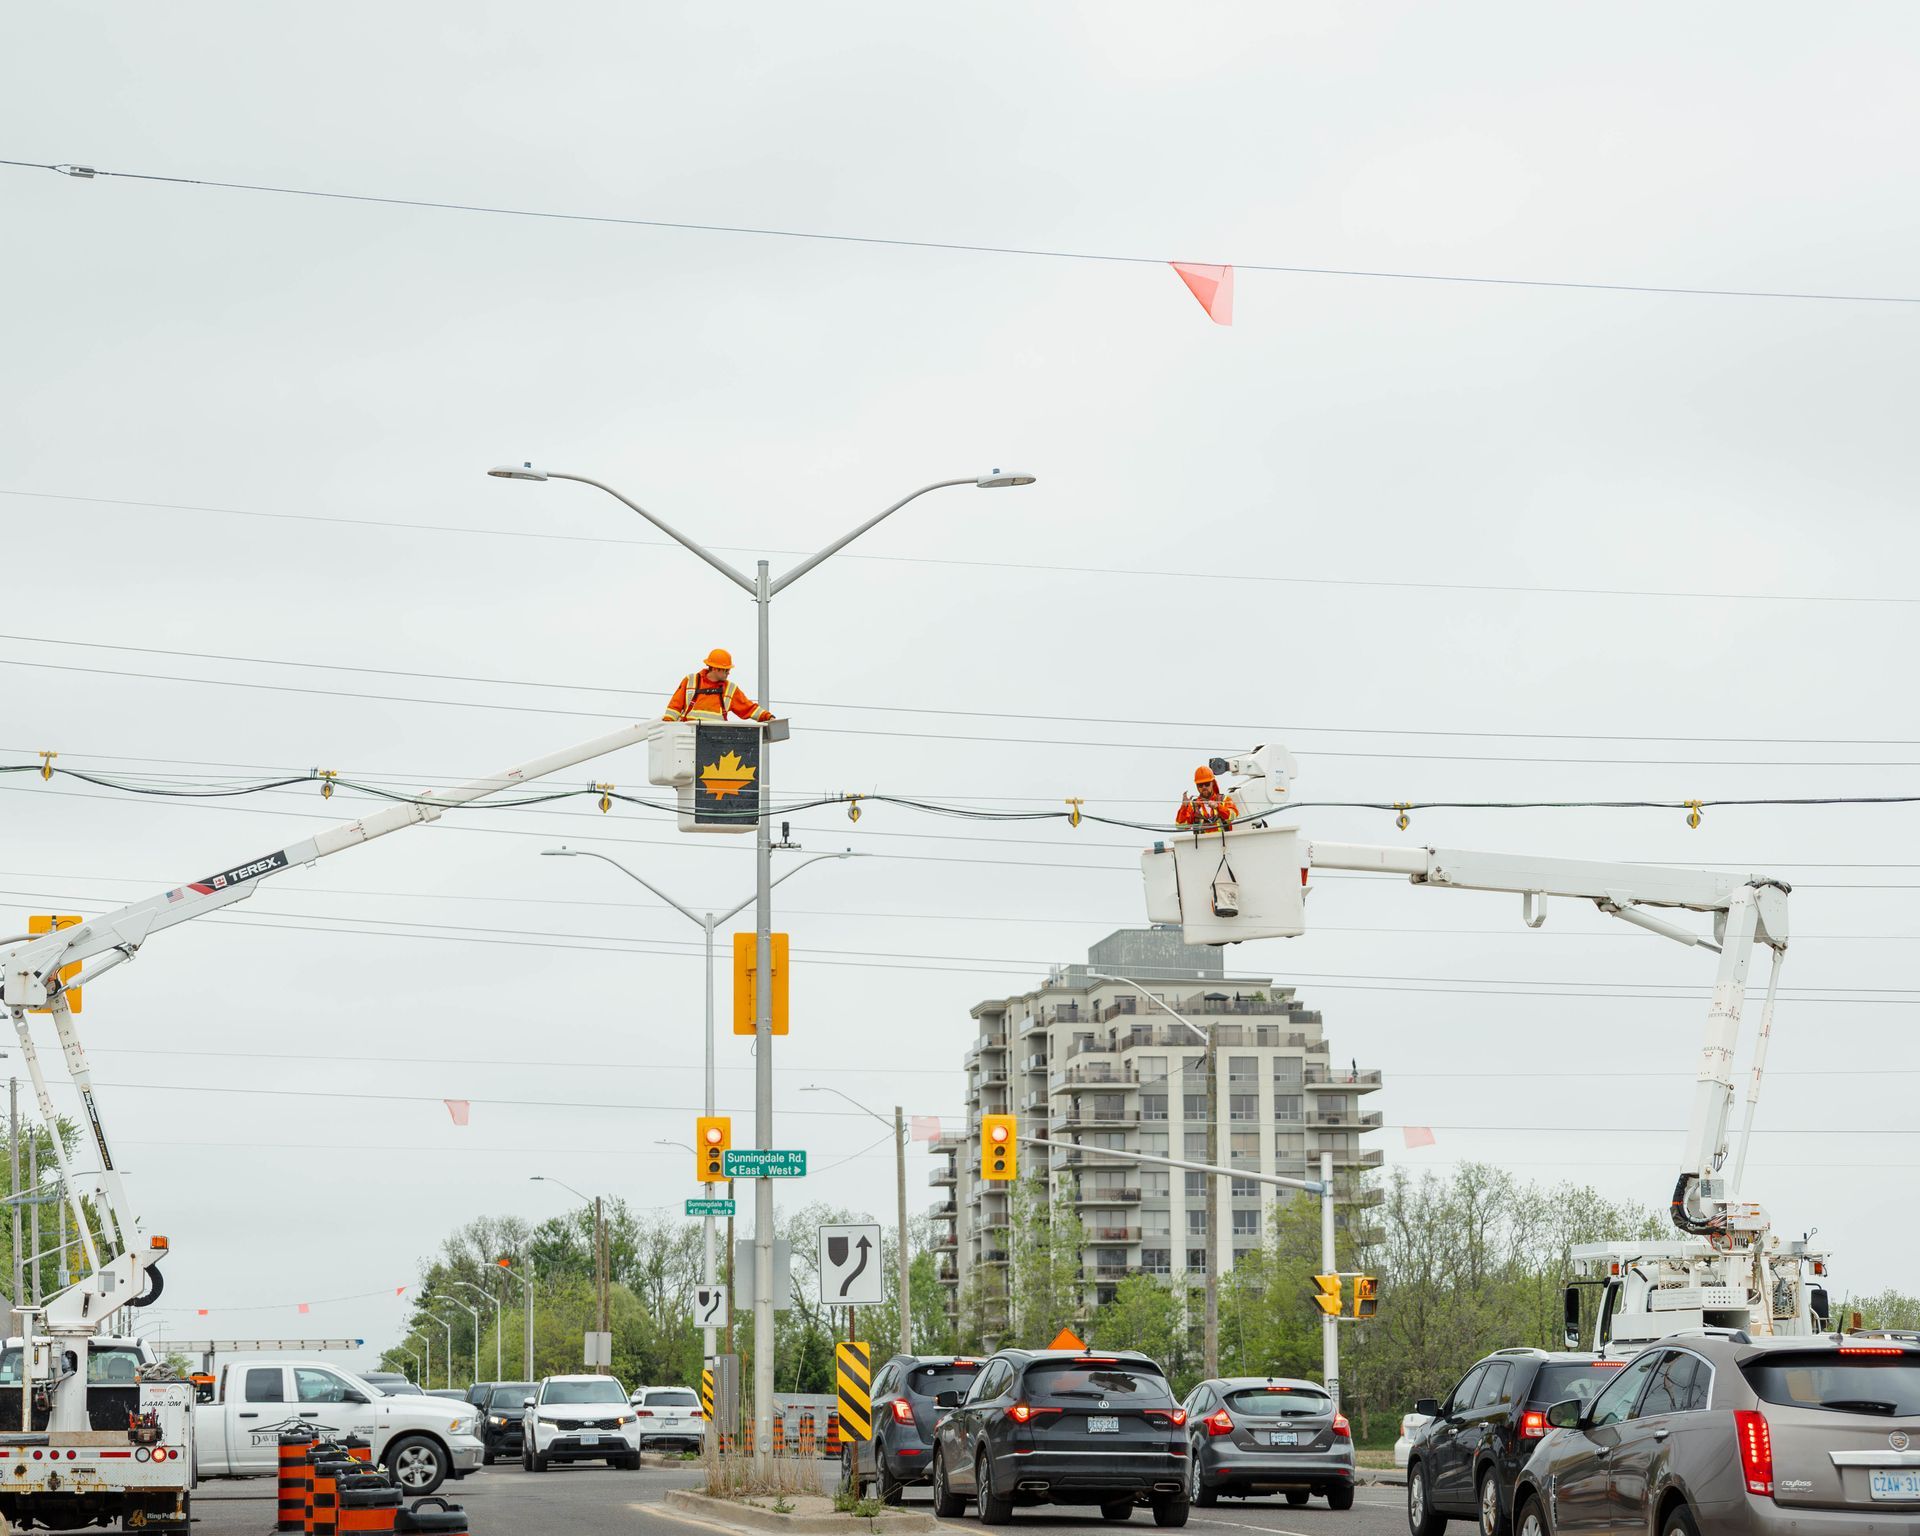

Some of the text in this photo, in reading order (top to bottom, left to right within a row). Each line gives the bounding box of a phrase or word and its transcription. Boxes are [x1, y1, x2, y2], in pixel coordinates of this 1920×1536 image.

[727, 1152, 804, 1164] Sunningdale Rd.
[739, 1165, 792, 1175] East West
[687, 1201, 723, 1209] Sunningdale
[1906, 1477, 1920, 1492] 31
